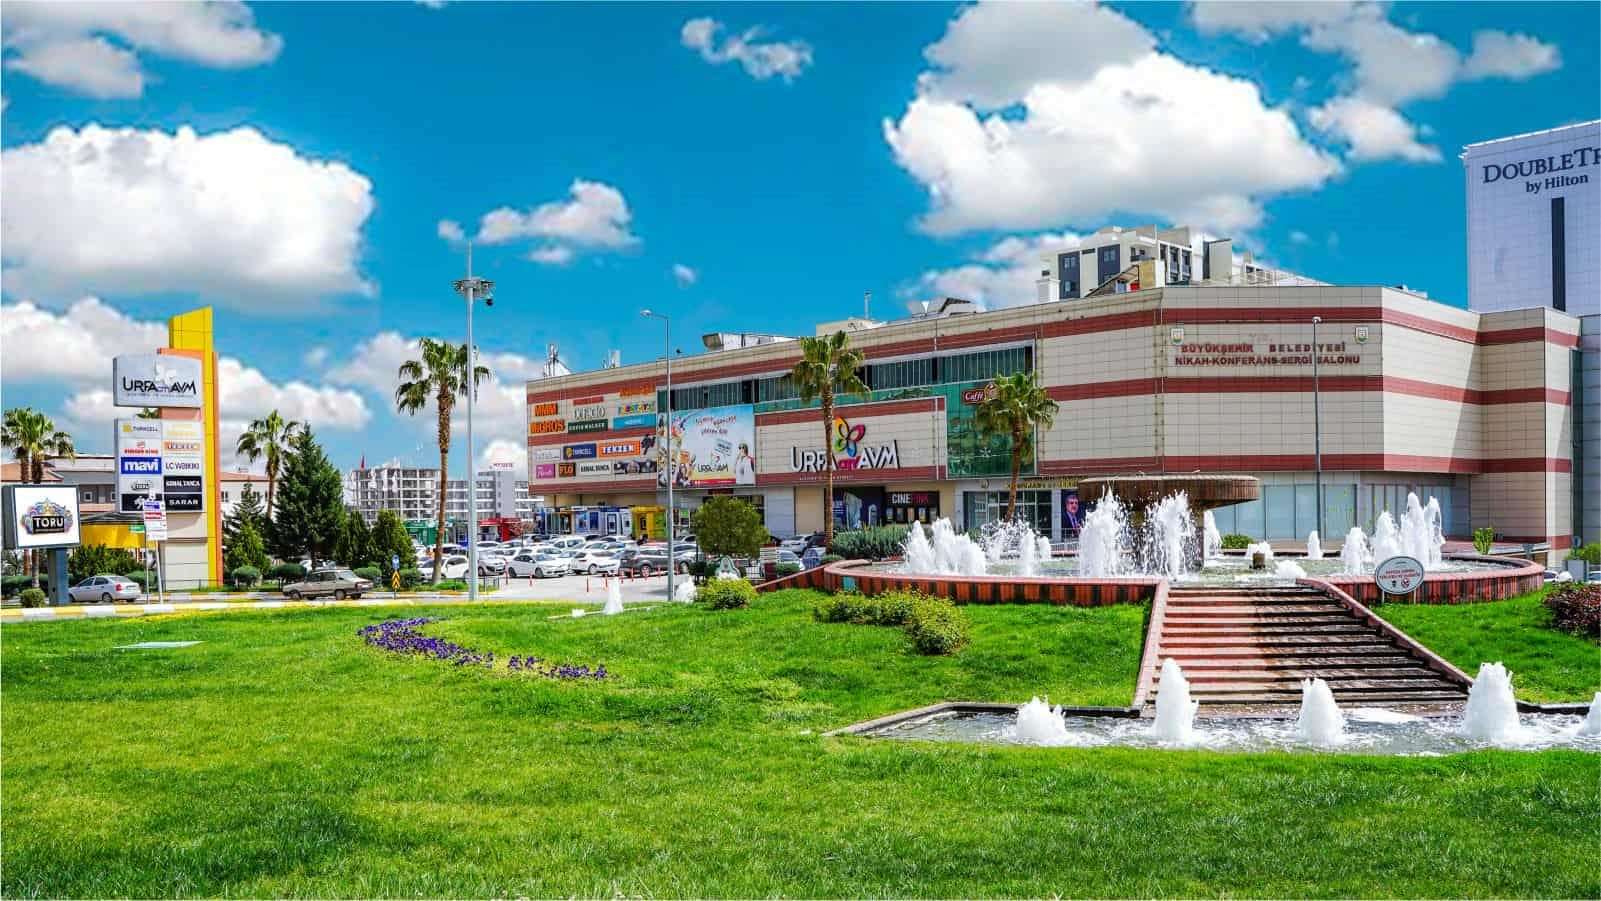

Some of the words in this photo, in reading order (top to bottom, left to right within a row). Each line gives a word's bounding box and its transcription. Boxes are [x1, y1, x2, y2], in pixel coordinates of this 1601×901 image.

[1525, 181, 1542, 194] by
[1545, 174, 1588, 190] Hilton
[1317, 355, 1360, 365] SALONU
[857, 440, 900, 469] AVM
[124, 458, 158, 471] mavi
[165, 462, 174, 470] LC
[559, 465, 574, 475] FLO
[33, 517, 64, 528] TORU
